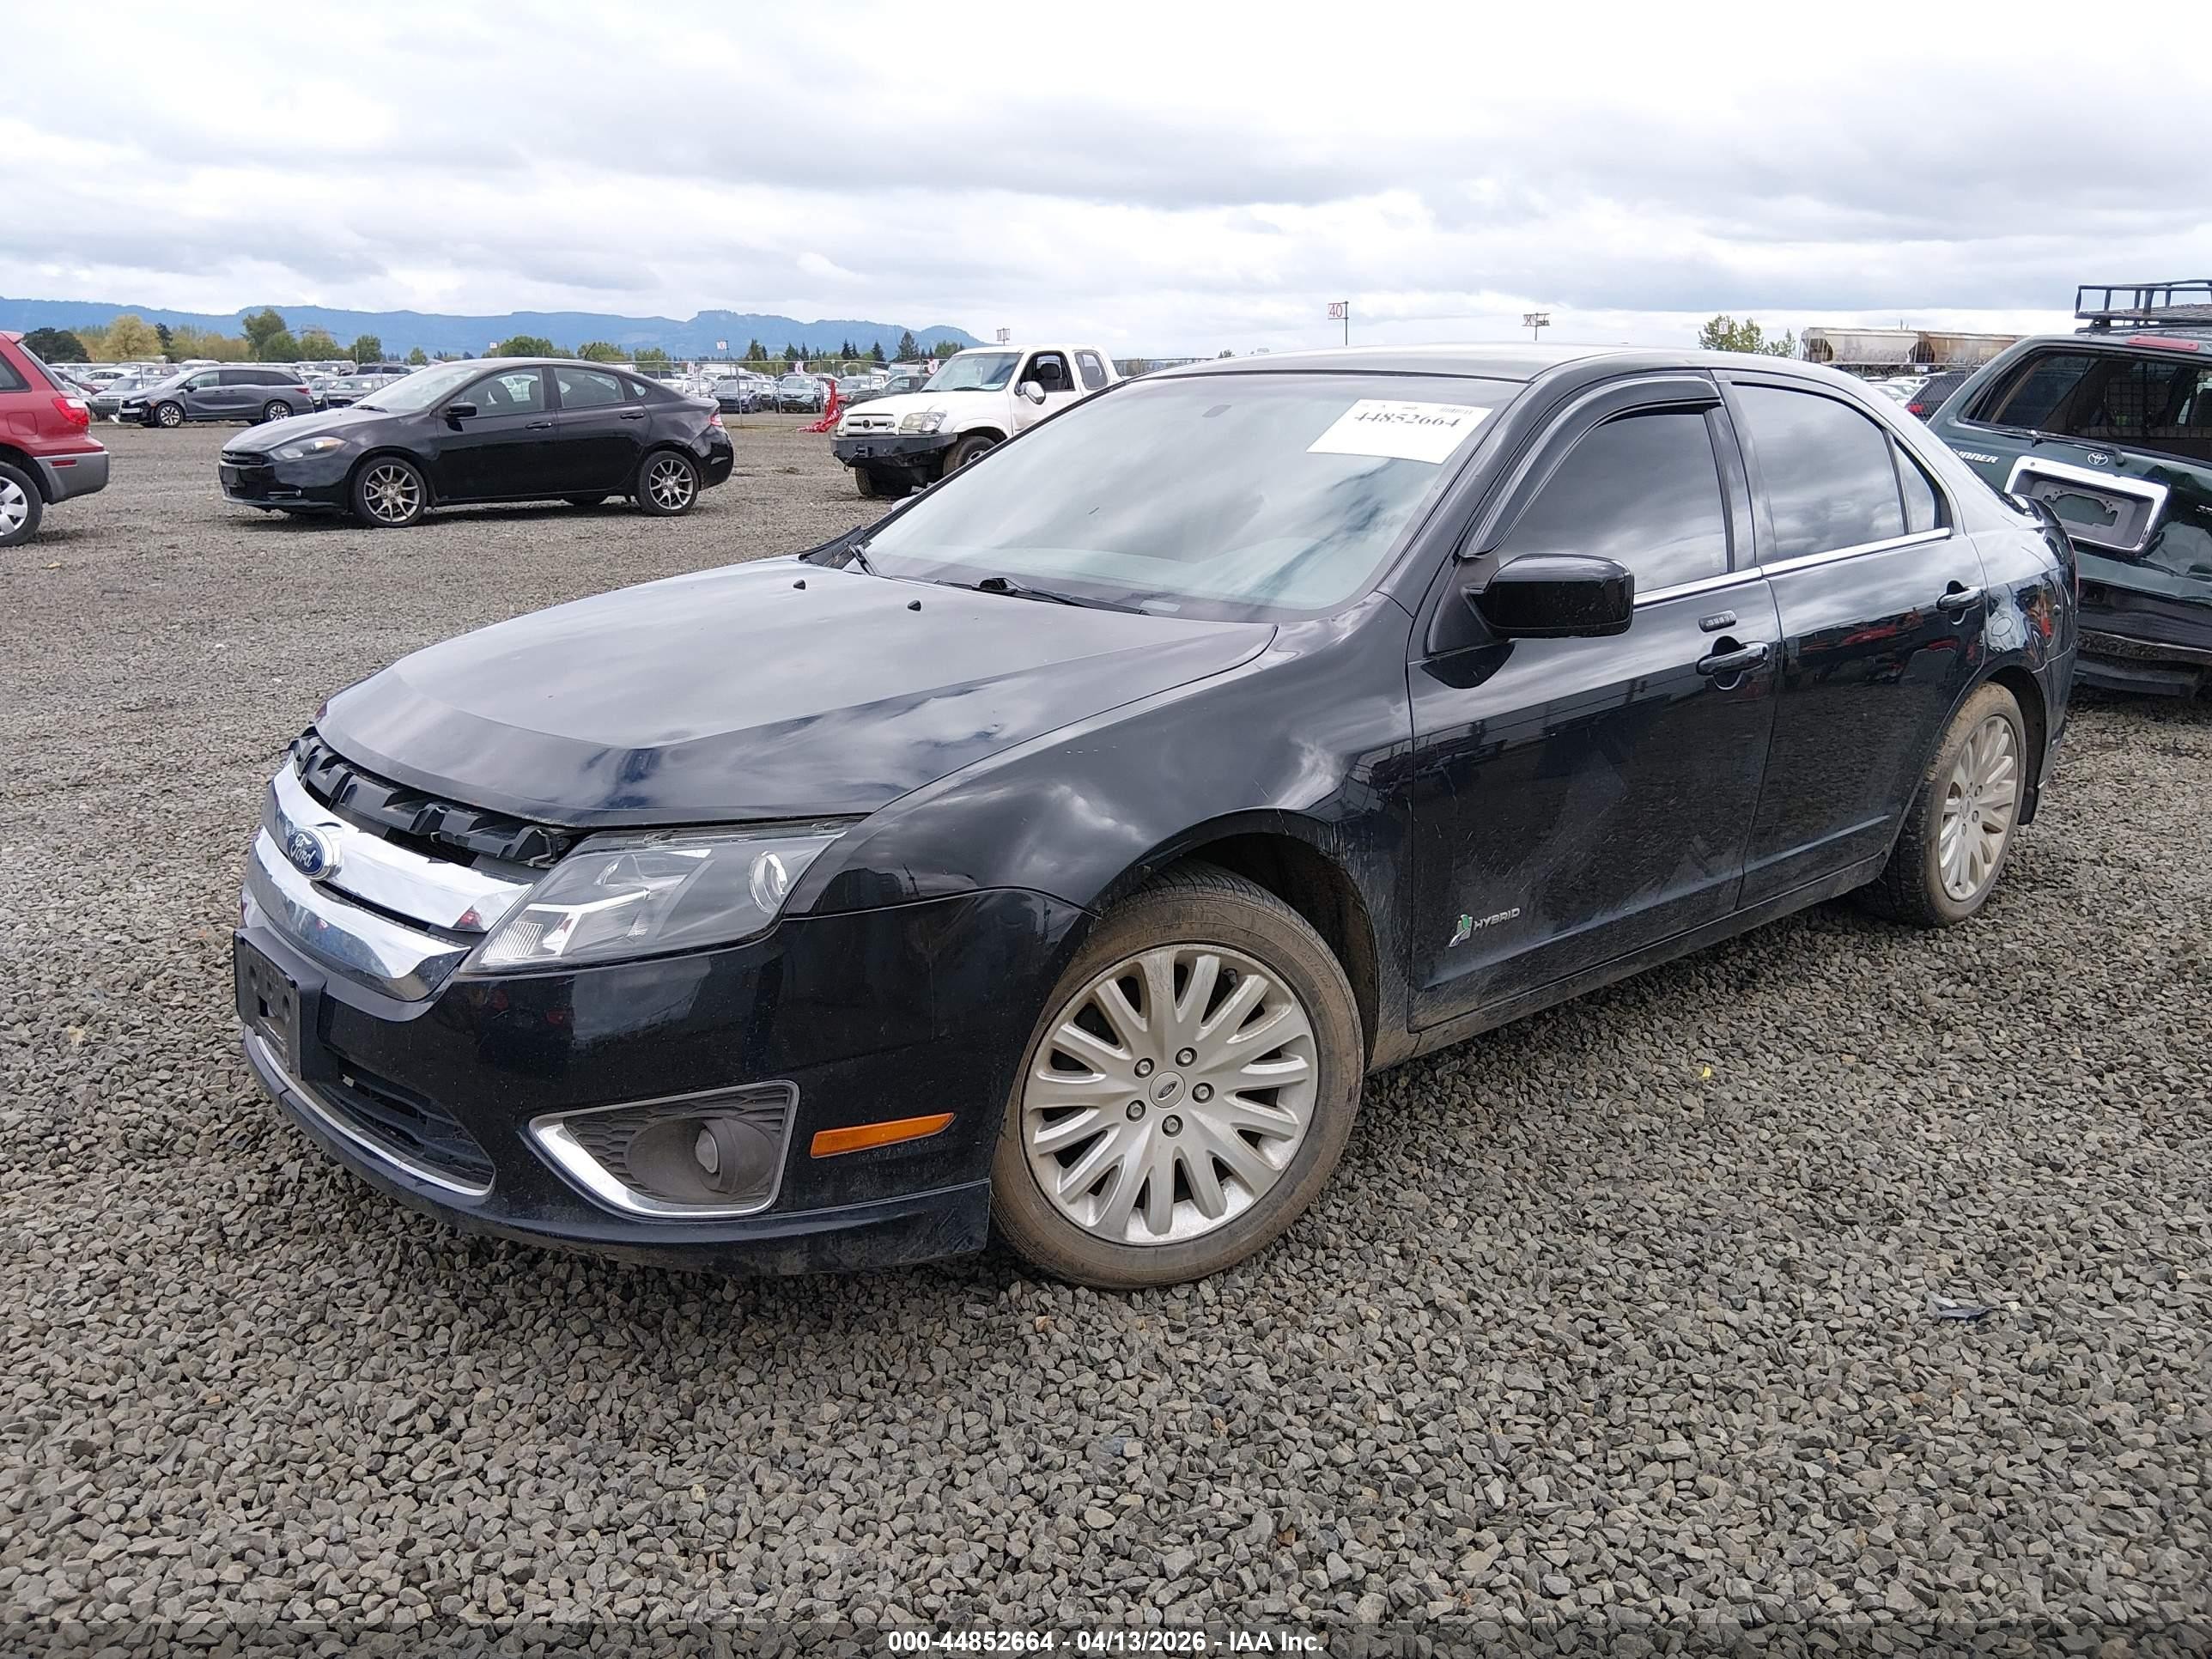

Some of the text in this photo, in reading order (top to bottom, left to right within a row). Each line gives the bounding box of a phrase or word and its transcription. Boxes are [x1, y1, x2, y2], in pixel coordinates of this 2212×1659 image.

[1328, 304, 1343, 318] 40
[1354, 411, 1461, 428] 44852664
[290, 833, 317, 868] Ford
[1473, 907, 1521, 932] HYBRID
